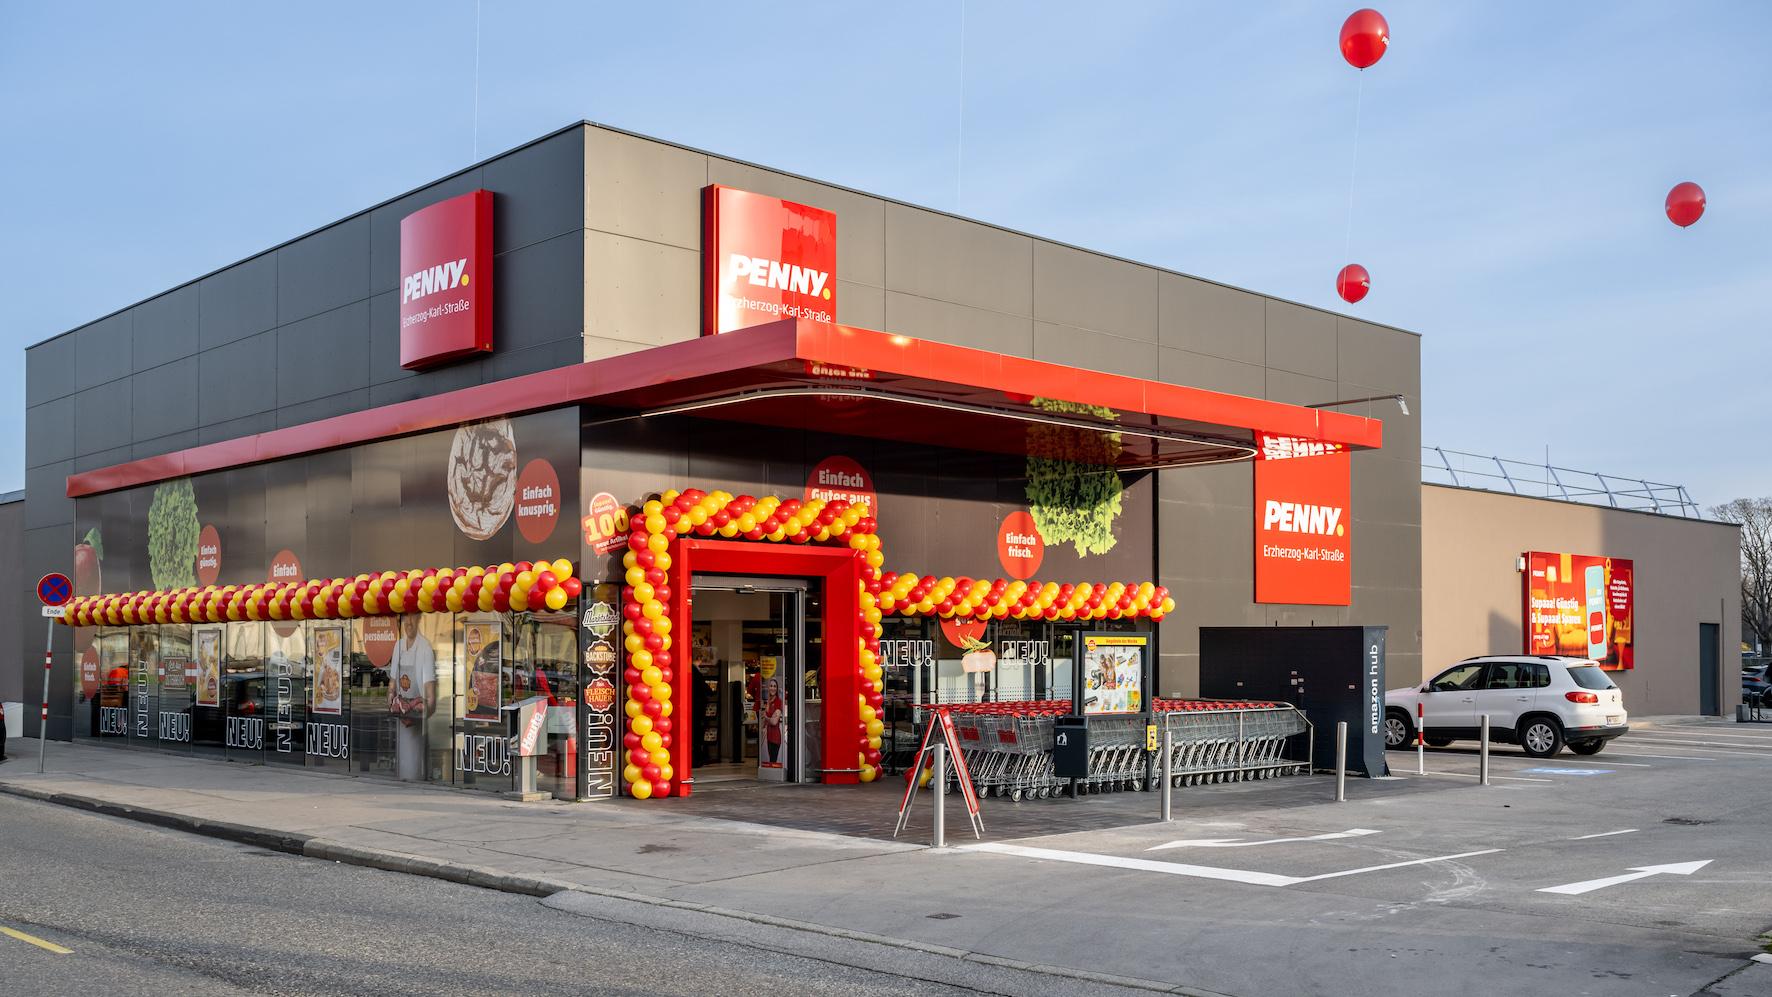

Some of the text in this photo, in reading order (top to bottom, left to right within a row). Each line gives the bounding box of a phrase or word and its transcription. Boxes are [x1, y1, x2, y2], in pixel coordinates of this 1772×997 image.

[403, 258, 470, 304] PENNY.
[728, 253, 831, 300] PENNY.
[733, 296, 831, 323] zherzog-Karl-Straße
[818, 469, 864, 487] Einfach
[522, 485, 552, 500] Einfach
[811, 488, 871, 506] Gutes aus
[518, 500, 557, 517] knusprig.
[1263, 500, 1345, 537] PENNY.
[585, 509, 630, 542] 100
[1006, 532, 1036, 546] Einfach
[201, 545, 217, 556] Einfach
[1008, 546, 1034, 558] frisch.
[1263, 544, 1345, 562] Erzherzog-Karl-Straße
[273, 563, 297, 577] Einfach
[46, 608, 61, 616] Ende
[364, 630, 397, 643] persönlich.
[585, 651, 617, 663] BACKSTUBE
[879, 640, 933, 667] NEU!
[1001, 640, 1050, 667] NEU!
[137, 660, 149, 738] NEU!
[1369, 644, 1379, 734] amazon hub
[100, 706, 128, 735] NEU!
[277, 664, 293, 753] NEU!
[159, 711, 191, 742] NEU!
[226, 716, 263, 750] NEU!
[521, 712, 544, 751] Heute
[306, 722, 349, 759] NEU!
[455, 735, 511, 776] NEU!
[588, 713, 614, 798] NEU!
